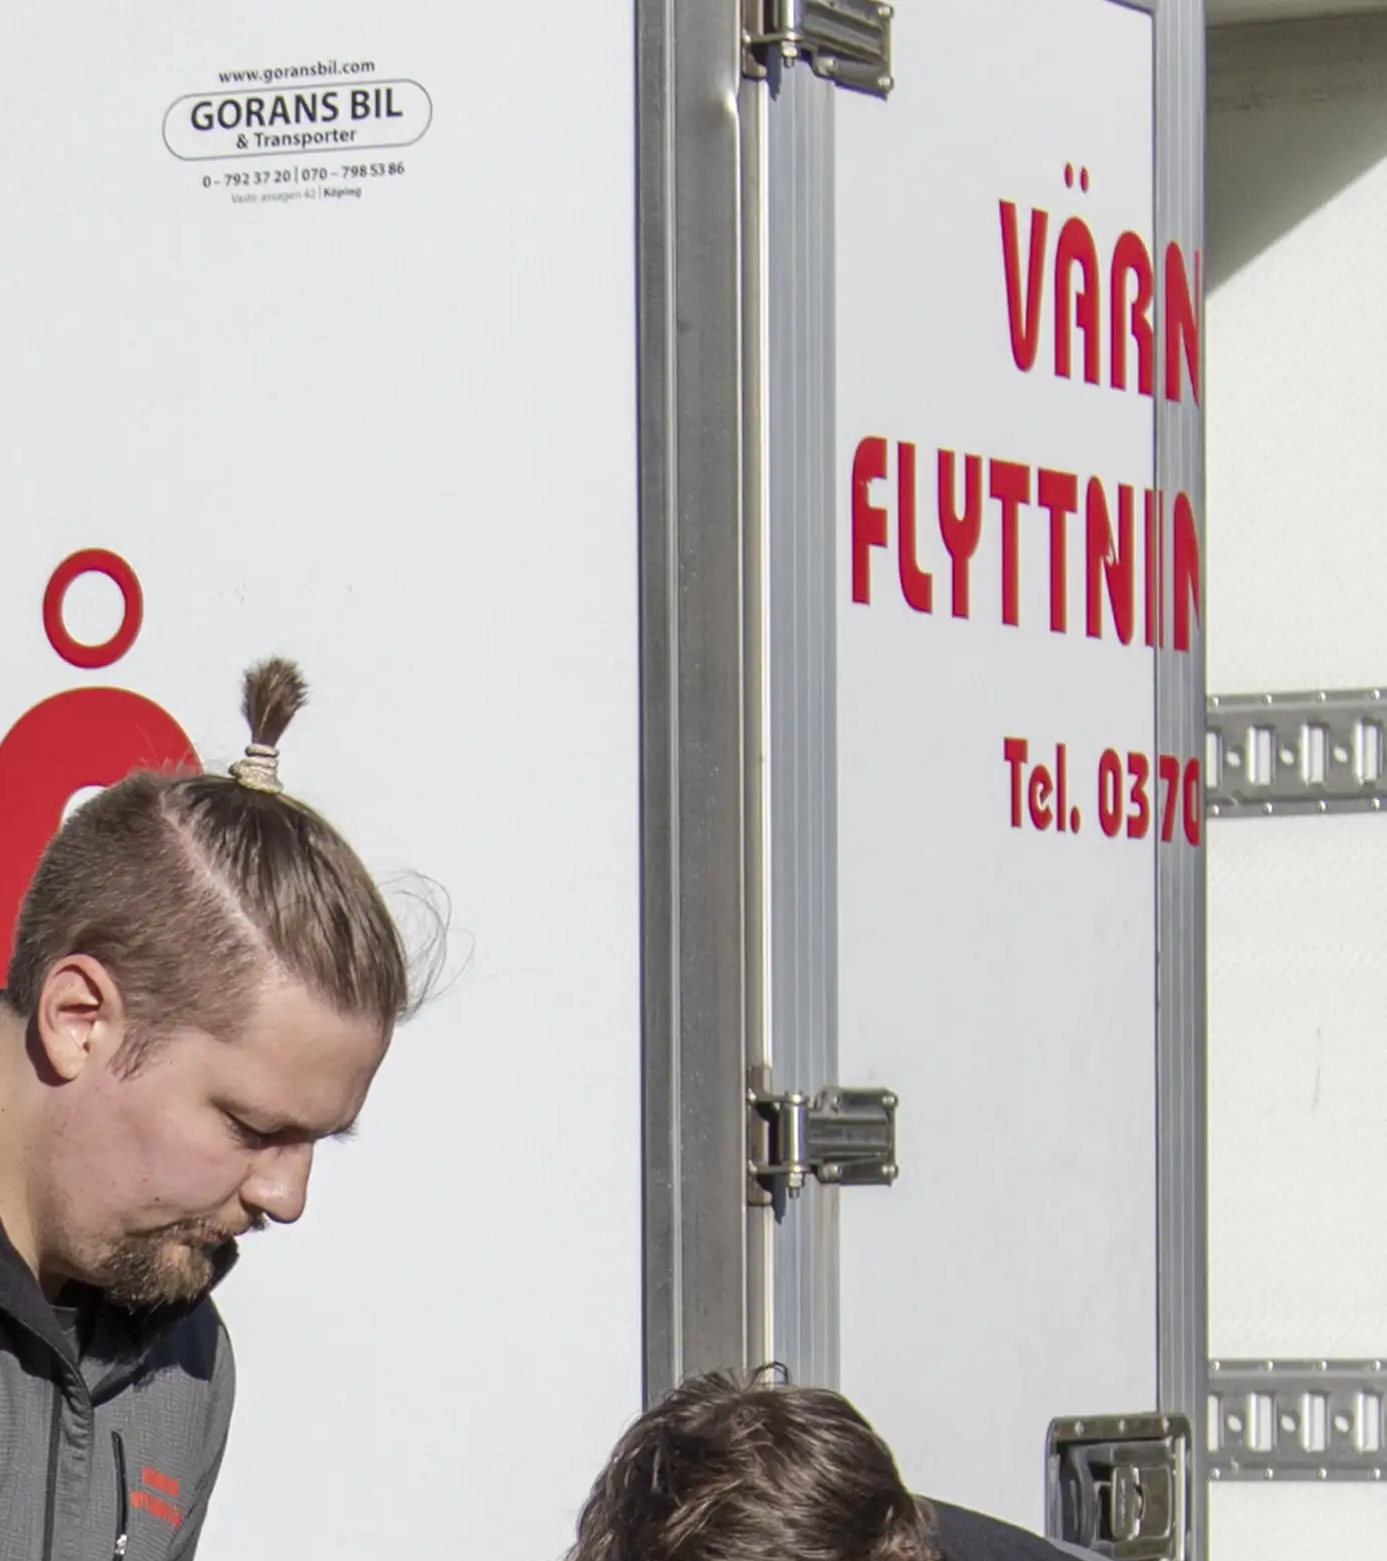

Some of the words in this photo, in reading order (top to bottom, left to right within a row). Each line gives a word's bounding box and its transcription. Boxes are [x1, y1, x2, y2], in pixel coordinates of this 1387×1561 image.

[218, 59, 375, 84] www.goransbil.com
[190, 91, 339, 131] GORANS
[350, 88, 404, 120] BIL
[236, 133, 249, 149] &
[253, 129, 357, 149] Transporter
[1004, 737, 1080, 834] Tel.
[1098, 748, 1200, 847] 0370
